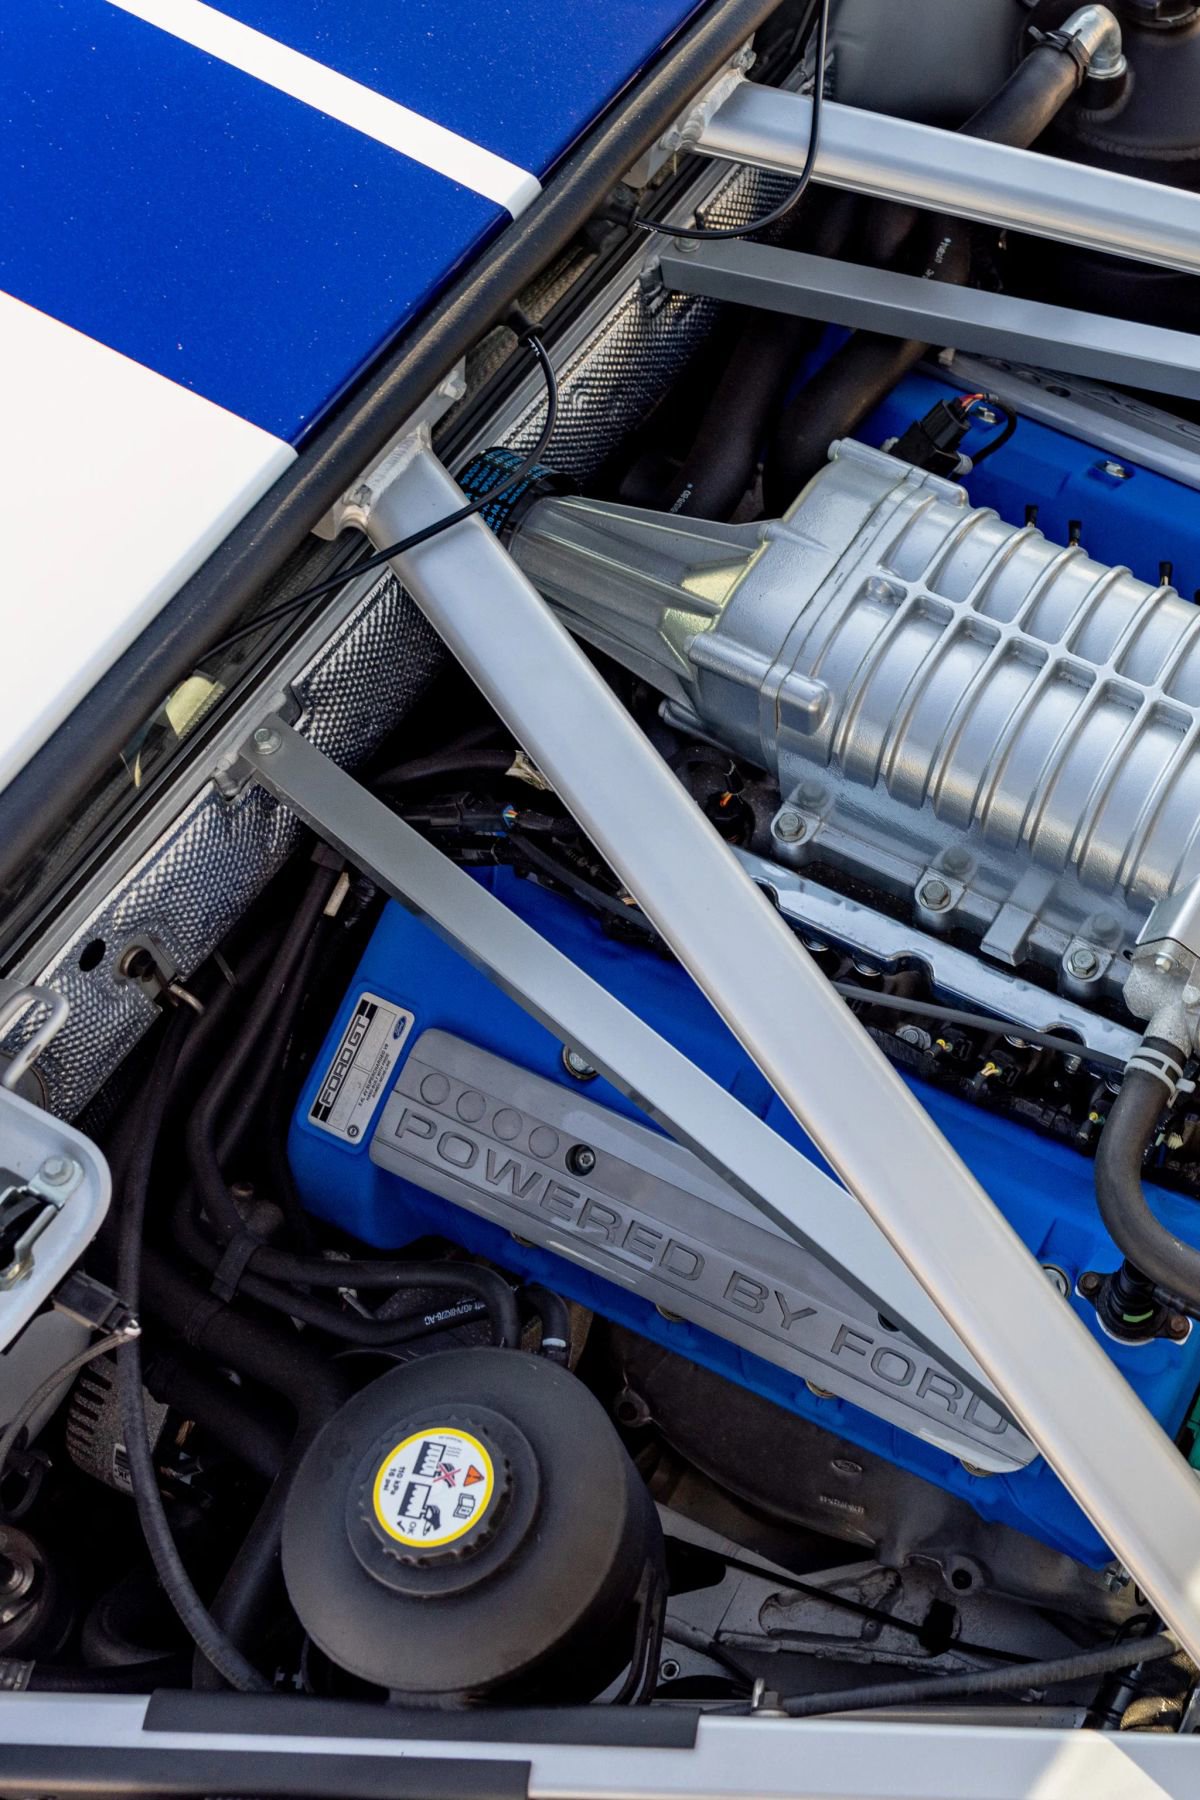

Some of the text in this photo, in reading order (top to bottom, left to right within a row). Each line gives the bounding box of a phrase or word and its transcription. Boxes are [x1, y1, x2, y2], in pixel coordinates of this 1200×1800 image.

[321, 1050, 353, 1105] FORD
[348, 1016, 366, 1047] GT
[394, 1108, 1010, 1434] POWERED BY FORD
[388, 1468, 395, 1477] 16
[389, 1465, 404, 1495] 110 kPa
[407, 1521, 416, 1535] OK
